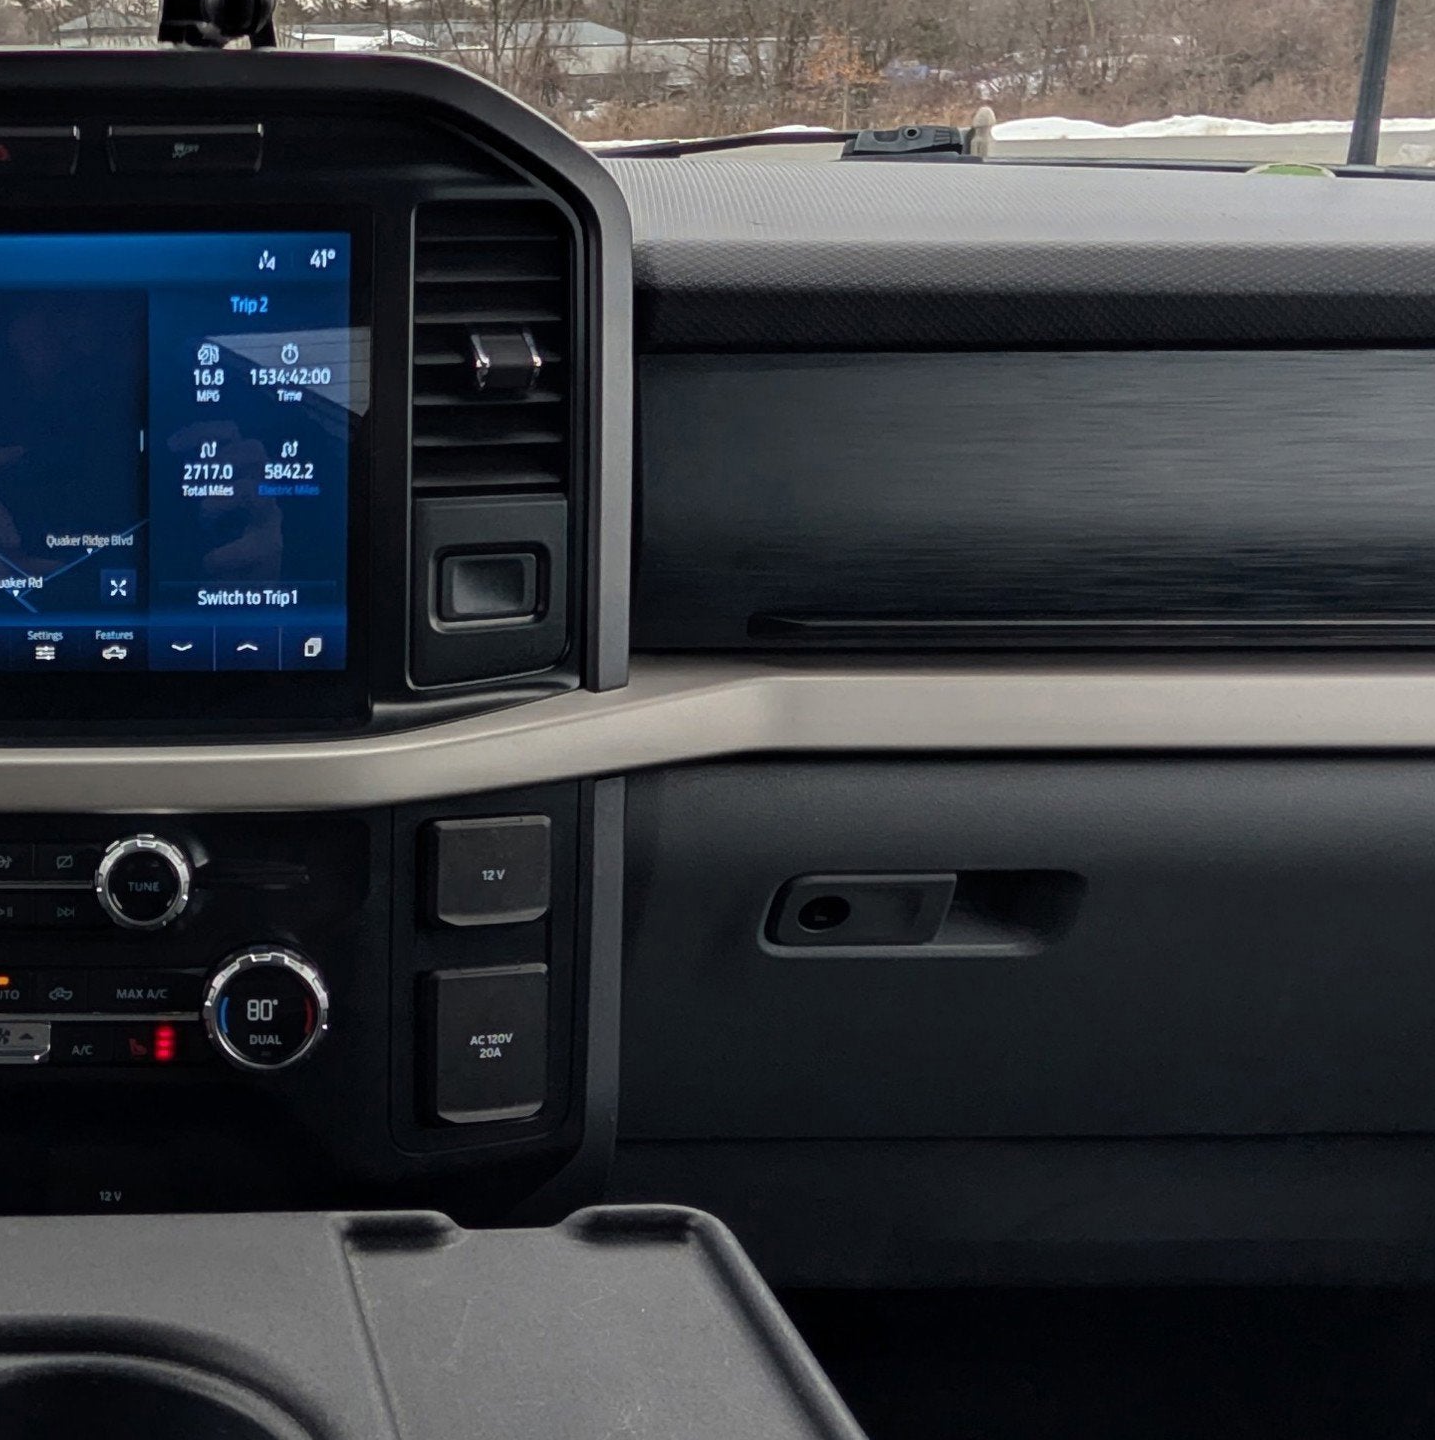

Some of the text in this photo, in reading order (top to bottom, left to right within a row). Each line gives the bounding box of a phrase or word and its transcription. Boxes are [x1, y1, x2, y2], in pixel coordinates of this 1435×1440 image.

[230, 295, 269, 316] Trip 2
[194, 368, 225, 386] 16.8
[250, 367, 332, 385] 1534:42:00
[196, 389, 221, 402] MPG
[277, 389, 303, 402] Time
[183, 463, 234, 481] 2717.0
[264, 462, 314, 480] 5842.2
[182, 484, 235, 497] Total Miles
[46, 534, 134, 549] Quaker Ridge Blvd
[28, 576, 44, 589] Rd
[197, 588, 244, 606] Switch
[247, 590, 261, 606] to
[263, 589, 290, 610] Trip
[27, 629, 64, 644] Settings
[95, 629, 133, 642] Features
[482, 869, 506, 881] 12 V
[128, 881, 160, 893] TUNE
[116, 988, 169, 1000] MAX A/C
[246, 998, 280, 1021] 80°
[249, 1034, 283, 1046] DUAL
[470, 1033, 514, 1046] AC 120V
[72, 1044, 93, 1057] A/C
[479, 1047, 502, 1059] 20A
